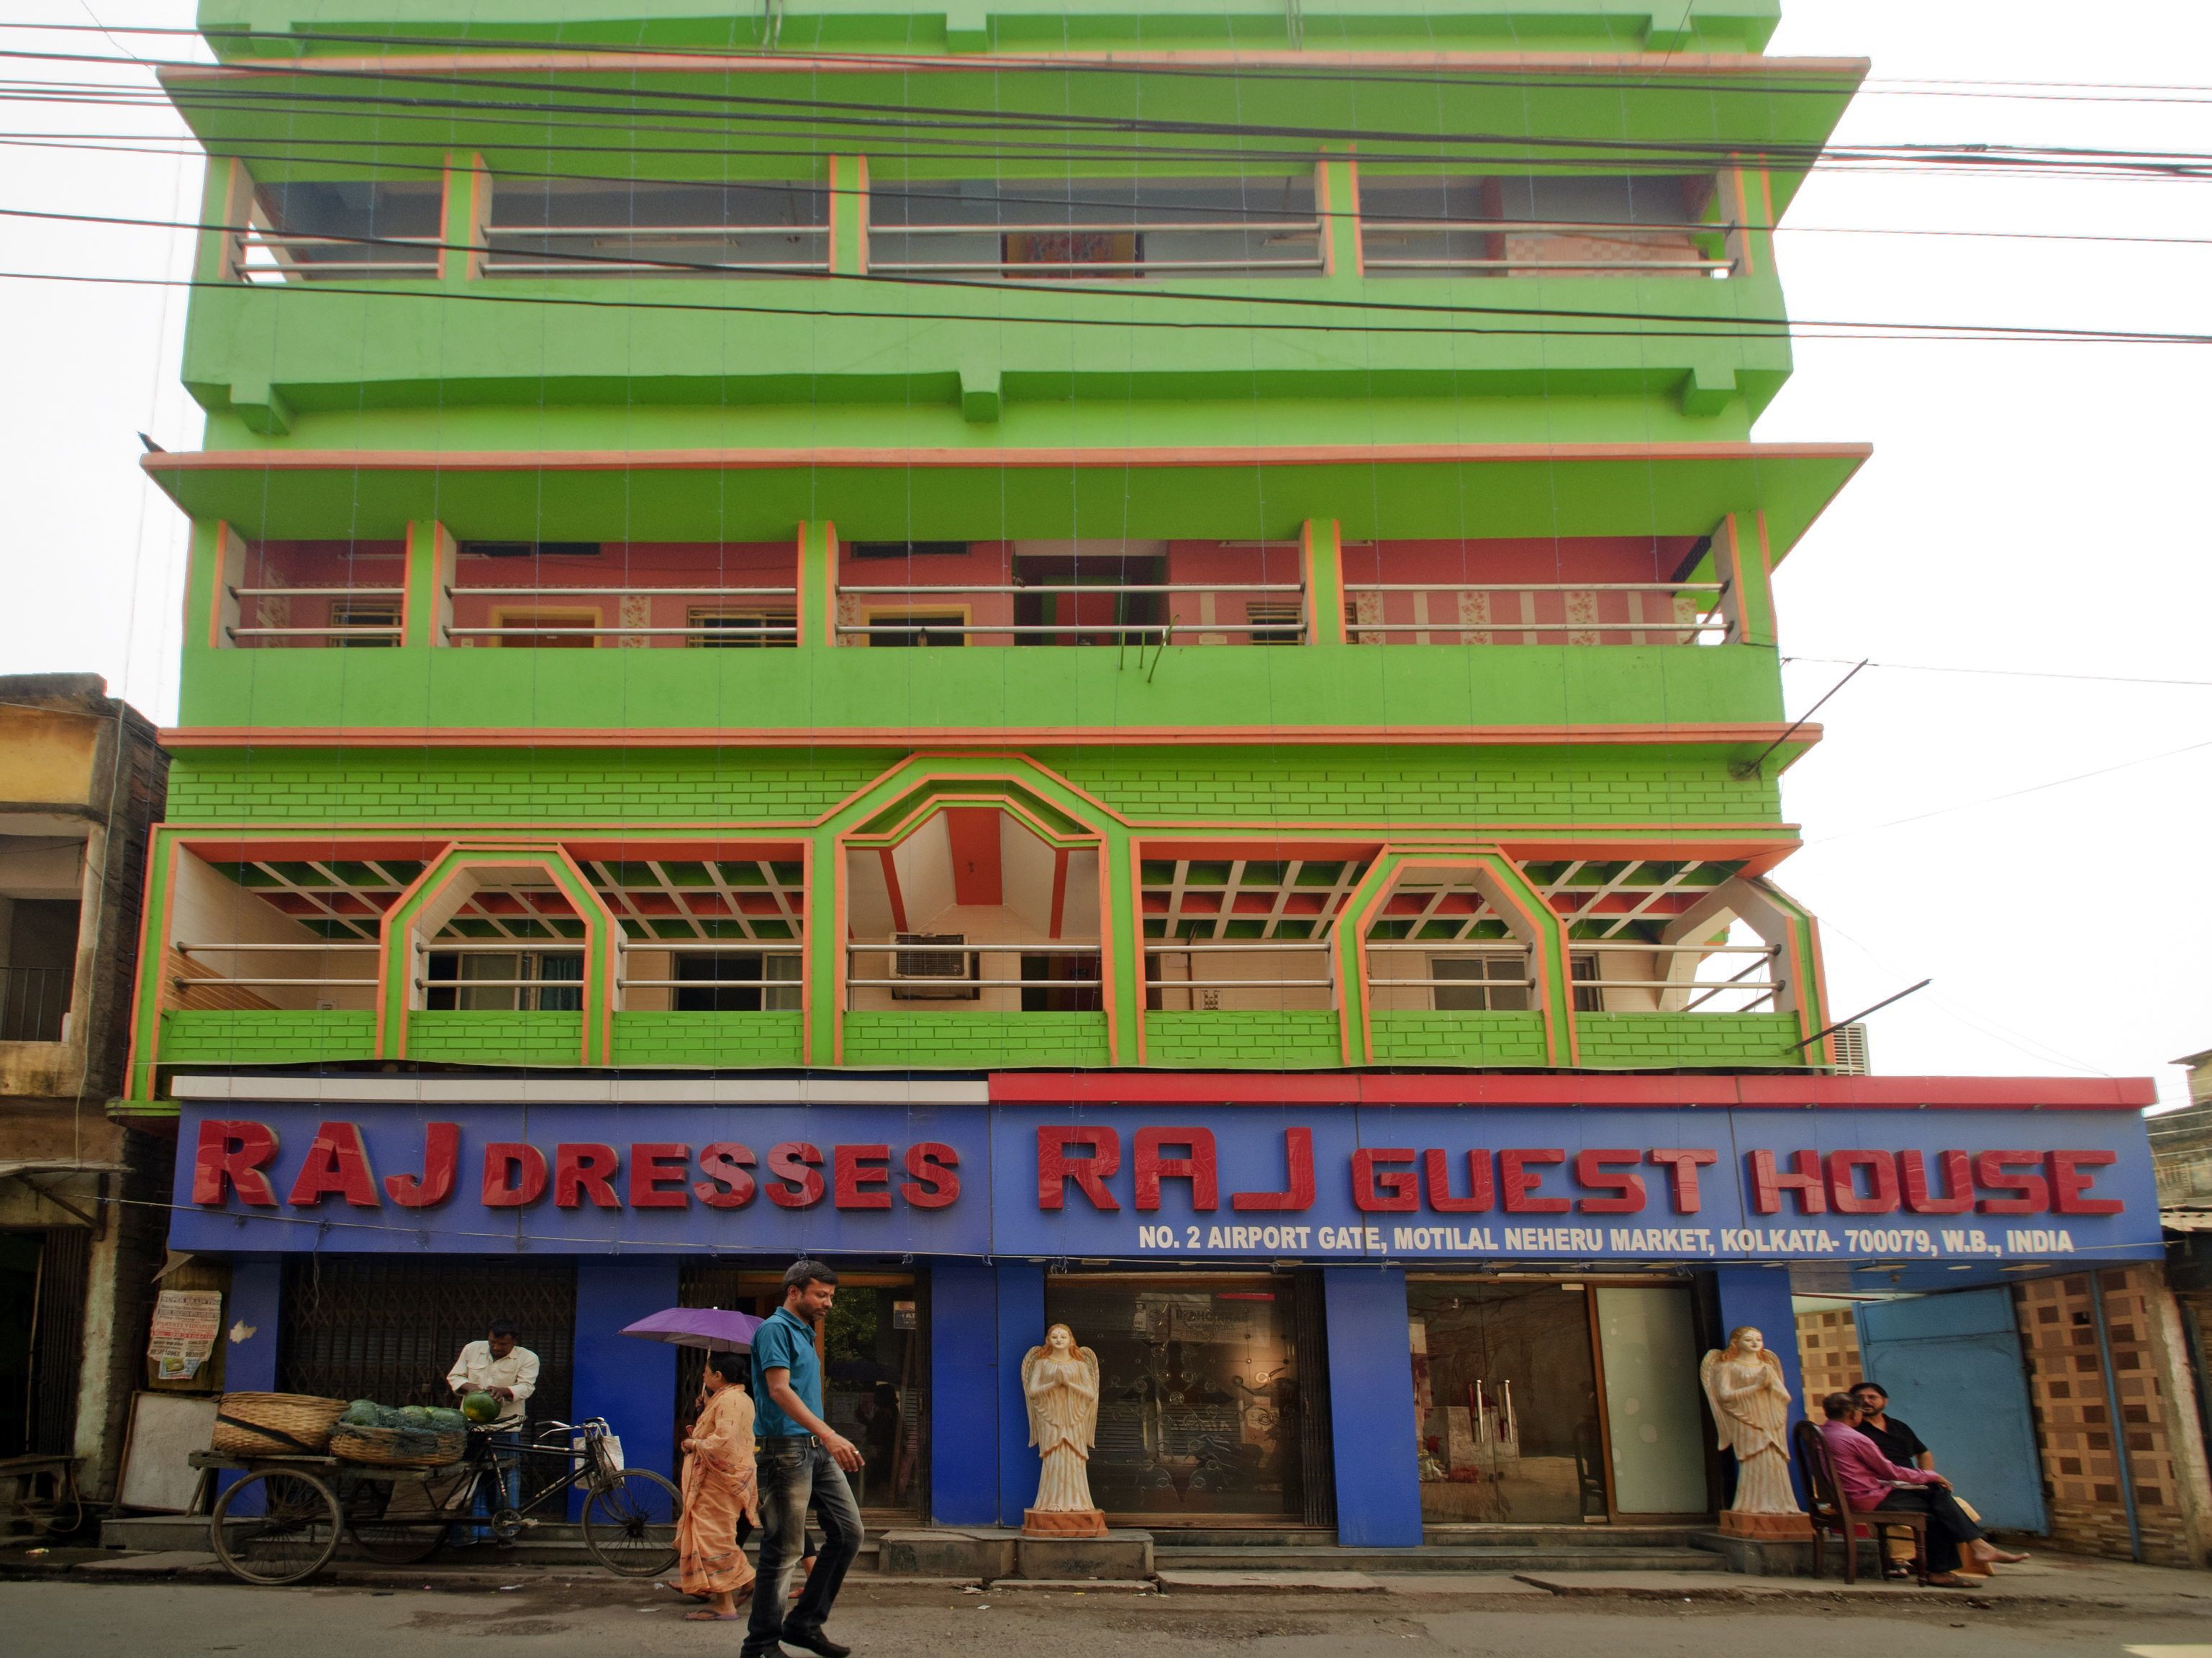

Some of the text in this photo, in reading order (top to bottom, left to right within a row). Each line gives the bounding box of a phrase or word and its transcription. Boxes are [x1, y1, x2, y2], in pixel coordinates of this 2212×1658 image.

[191, 1120, 961, 1209] RAJ DRESSES
[1038, 1125, 2124, 1213] RAJ GUEST HOUSE
[1139, 1226, 2075, 1257] NO. 2 AIRPORT GATE, MOTILAL NEHERU MARKET, KOLKATA- 700079, W.B., INDIA
